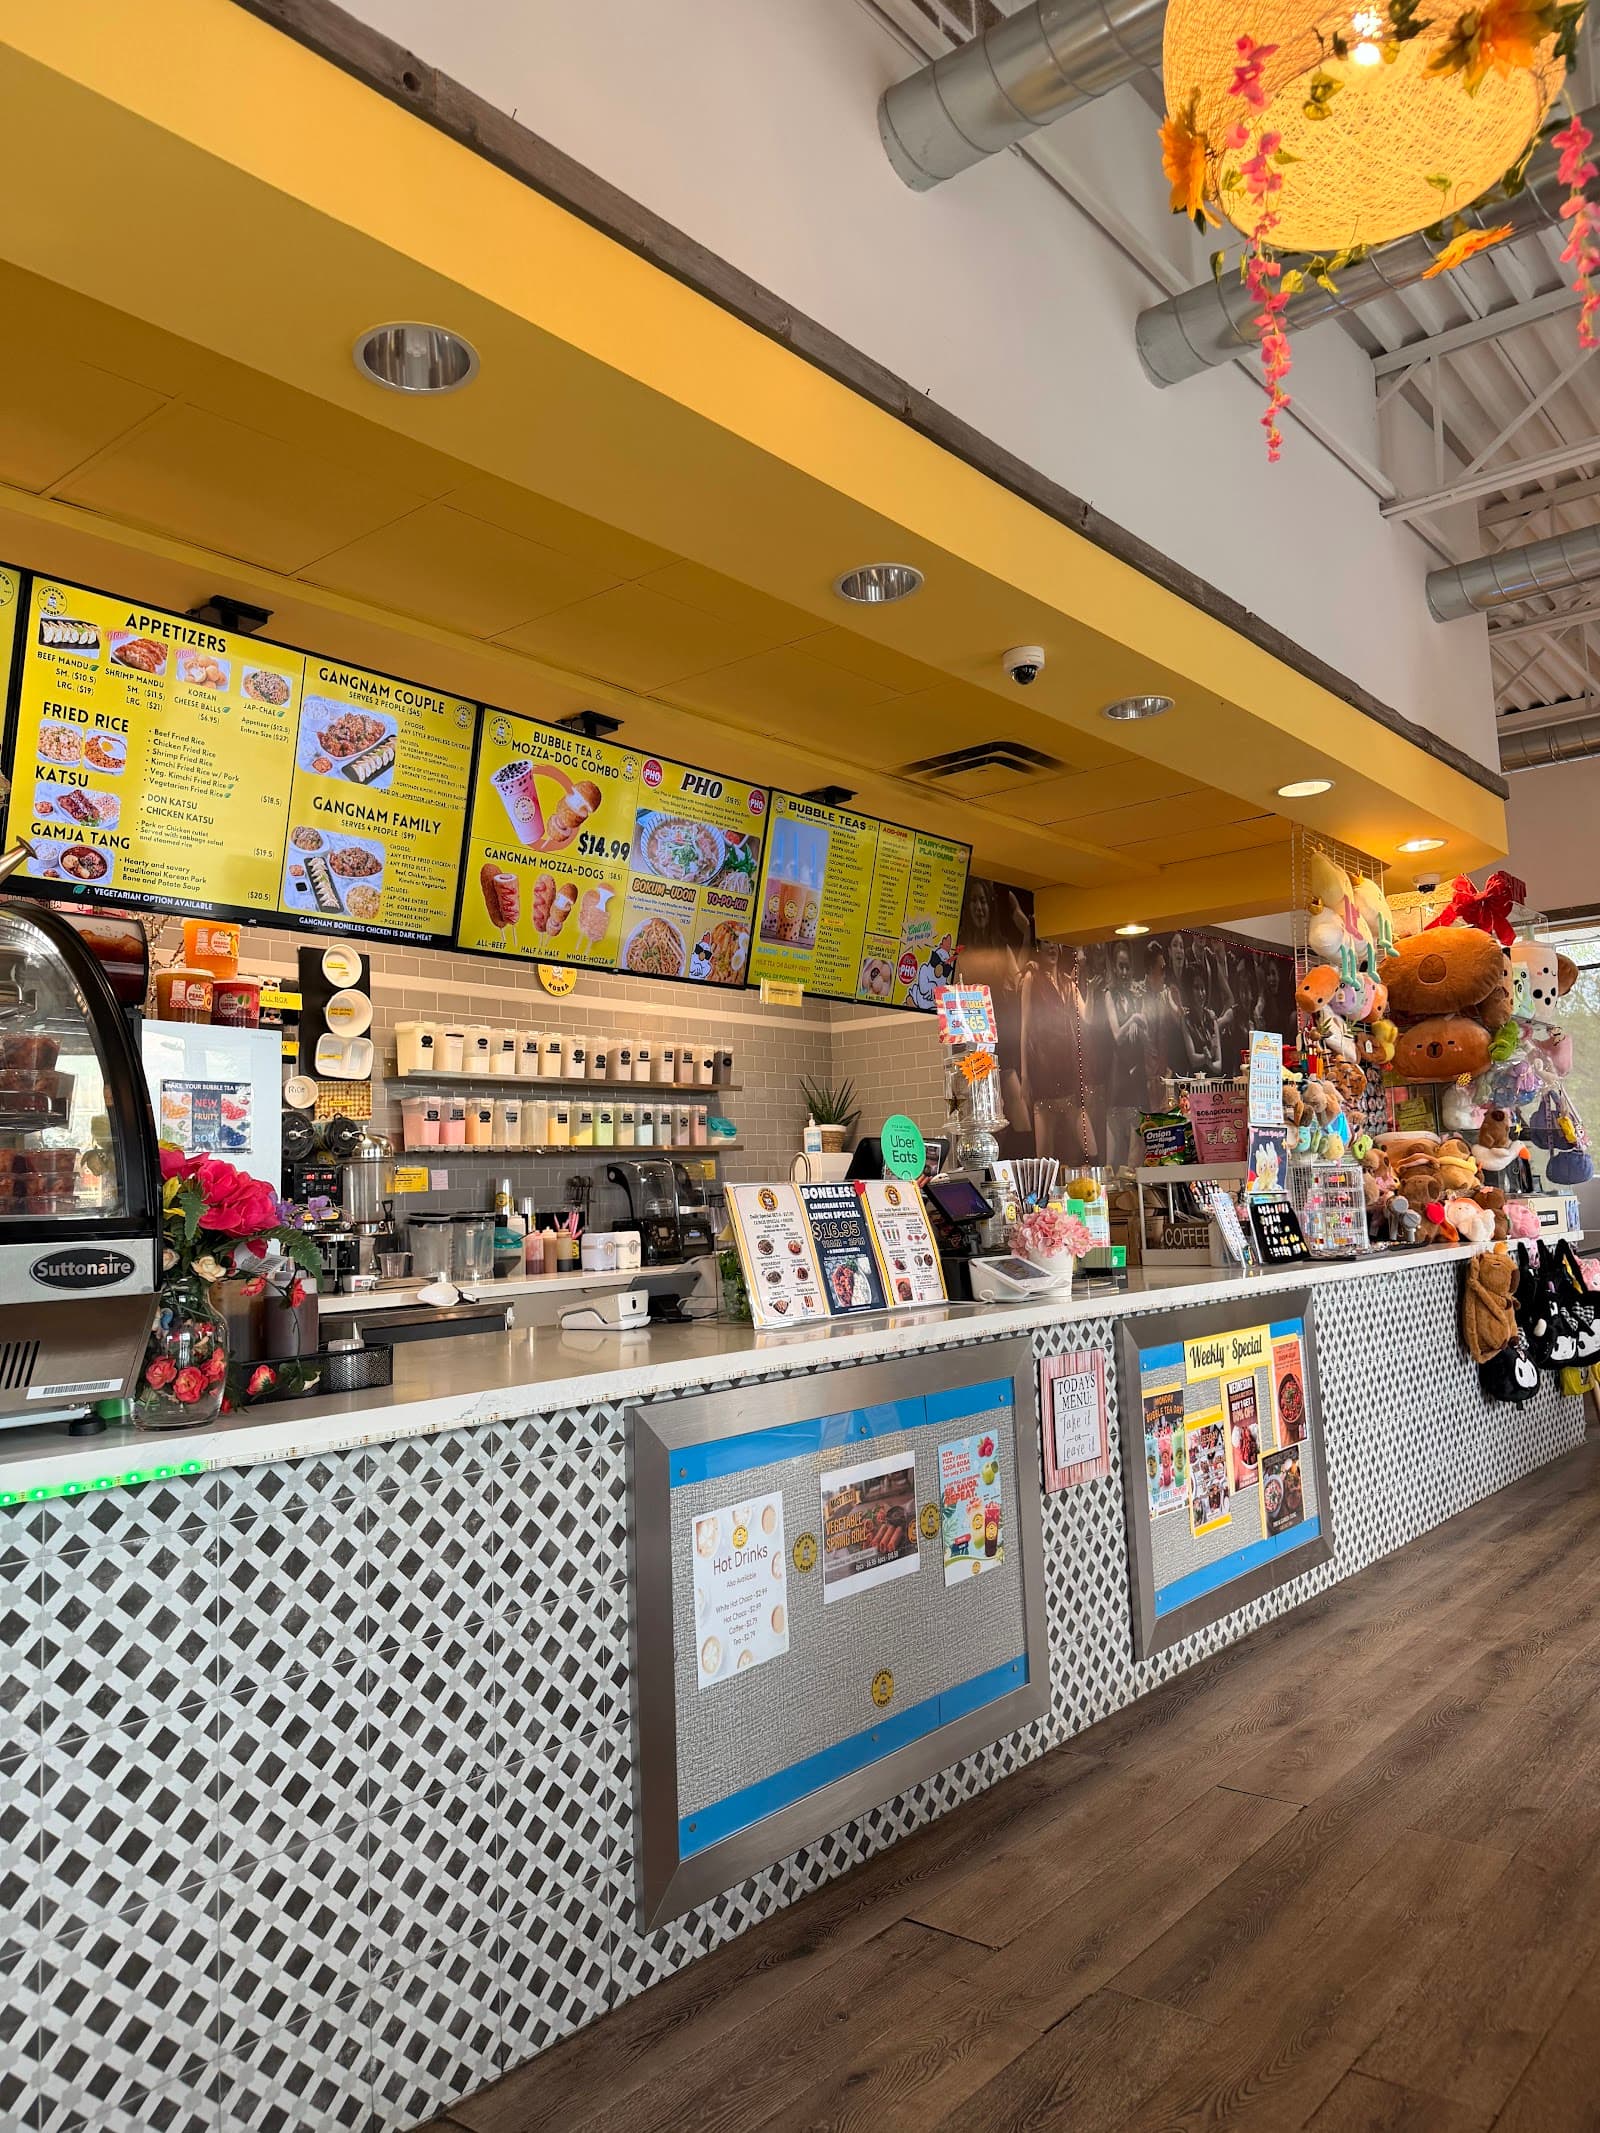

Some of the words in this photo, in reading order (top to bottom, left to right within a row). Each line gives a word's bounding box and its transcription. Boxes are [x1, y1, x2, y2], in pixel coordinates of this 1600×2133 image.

[125, 612, 227, 653] APPETIZERS
[37, 651, 56, 662] BEEF
[58, 656, 89, 670] MANDU
[105, 668, 134, 680] SHRIMP
[136, 676, 165, 688] MANDU
[188, 687, 217, 701] KOREAN
[319, 667, 390, 698] GANGNAM
[394, 689, 445, 715] COUPLE
[174, 696, 199, 710] CHEESE
[200, 701, 222, 714] BALLS
[243, 704, 276, 717] JAP-CHAE
[348, 691, 373, 704] SERVES
[380, 700, 406, 713] PEOPLE
[43, 701, 89, 724] FRIED
[95, 713, 129, 733] RICE
[154, 728, 170, 738] Beef
[171, 733, 189, 743] Fried
[190, 736, 205, 746] Rice
[533, 731, 572, 752] BUBBLE
[575, 743, 592, 758] TEA
[595, 749, 603, 761] &
[152, 748, 178, 761] Shrimp
[179, 754, 198, 764] Fried
[199, 757, 213, 767] Rice
[153, 738, 182, 750] Chicken
[183, 745, 201, 755] Fried
[202, 748, 216, 758] Rice
[151, 758, 176, 770] Kimchi
[176, 763, 195, 773] Fried
[196, 767, 210, 777] Rice
[512, 739, 579, 768] MOZZA-DOG
[581, 758, 619, 779] COMBO
[35, 765, 89, 787] KATSU
[150, 768, 166, 779] Veg.
[168, 771, 193, 783] Kimchi
[193, 776, 212, 787] Fried
[213, 780, 227, 789] Rice
[645, 769, 660, 781] PHO
[150, 777, 189, 792] Vegetarian
[190, 785, 208, 796] Fried
[209, 789, 224, 799] Rice
[680, 772, 723, 799] PHO
[147, 793, 168, 804] DON
[169, 797, 198, 810] KATSU
[750, 798, 764, 810] PHO
[146, 806, 185, 820] CHICKEN
[186, 813, 214, 825] KATSU
[313, 796, 388, 824] GANGNAM
[393, 813, 442, 835] FAMILY
[788, 801, 835, 822] BUBBLE
[838, 815, 866, 830] TEAS
[31, 823, 84, 843] GAMJA
[90, 831, 130, 850] TANG
[166, 824, 190, 834] Chicken
[341, 819, 365, 831] SERVES
[373, 826, 398, 837] PEOPLE
[577, 830, 631, 862] $14.99
[918, 847, 955, 863] FLAVOURS
[124, 857, 149, 869] Hearty
[150, 861, 165, 869] and
[485, 847, 537, 867] GANGNAM
[539, 858, 605, 880] MOZZA-DOGS
[123, 866, 161, 877] traditional
[163, 872, 189, 881] Korean
[144, 877, 156, 885] and
[157, 879, 181, 888] Potato
[94, 887, 141, 901] VEGETARIAN
[143, 893, 173, 905] OPTION
[174, 898, 213, 911] AVAILABLE
[707, 891, 748, 911] TO-PO-KKI
[299, 916, 333, 928] GANGNAM
[333, 921, 365, 933] BONELESS
[366, 925, 392, 936] CHICKEN
[399, 930, 416, 940] DARK
[416, 932, 432, 942] MEAT
[476, 939, 507, 950] ALL-BEEF
[521, 946, 536, 955] HALF
[544, 949, 560, 958] HALF
[566, 953, 609, 965] WHOLE-MOZZA
[900, 965, 915, 976] PHO
[548, 982, 570, 992] KOREA
[185, 1083, 201, 1091] YOUR
[195, 1099, 217, 1108] NEW
[194, 1134, 220, 1143] BOBA
[890, 1134, 915, 1149] Uber
[1146, 1130, 1171, 1140] Onion
[893, 1149, 918, 1164] Eats
[801, 1186, 857, 1199] BONELESS
[809, 1211, 832, 1220] LUNCH
[833, 1210, 860, 1219] SPECIAL
[812, 1221, 860, 1241] $16.95
[1164, 1227, 1209, 1247] COFFEE
[37, 1258, 131, 1277] Suttonaire
[1189, 1342, 1225, 1368] Weekly
[1232, 1334, 1262, 1365] Special
[1057, 1374, 1096, 1395] TODAYS
[1062, 1391, 1092, 1410] MENU:
[1060, 1413, 1081, 1438] Take
[1084, 1409, 1091, 1425] it
[942, 1450, 953, 1458] NEW
[942, 1456, 955, 1465] FIZZY
[956, 1452, 970, 1461] FRUIT
[1063, 1443, 1086, 1462] Leave
[1088, 1436, 1095, 1453] it
[943, 1464, 956, 1472] SODA
[956, 1460, 970, 1468] BOBA
[830, 1496, 842, 1508] MUST
[944, 1490, 977, 1506] REPEAT.
[825, 1511, 862, 1535] VEGETABLE
[826, 1533, 851, 1553] SPRING
[851, 1530, 867, 1545] ROLL
[714, 1554, 732, 1575] Hot
[735, 1543, 768, 1568] Drinks
[726, 1579, 736, 1588] Also
[736, 1572, 757, 1585] Available
[715, 1604, 730, 1614] White
[730, 1601, 738, 1609] Hot
[739, 1595, 753, 1606] Choco
[723, 1614, 733, 1624] Hot
[734, 1609, 747, 1620] Choco
[728, 1624, 744, 1636] Coffee
[733, 1636, 742, 1646] Tea
